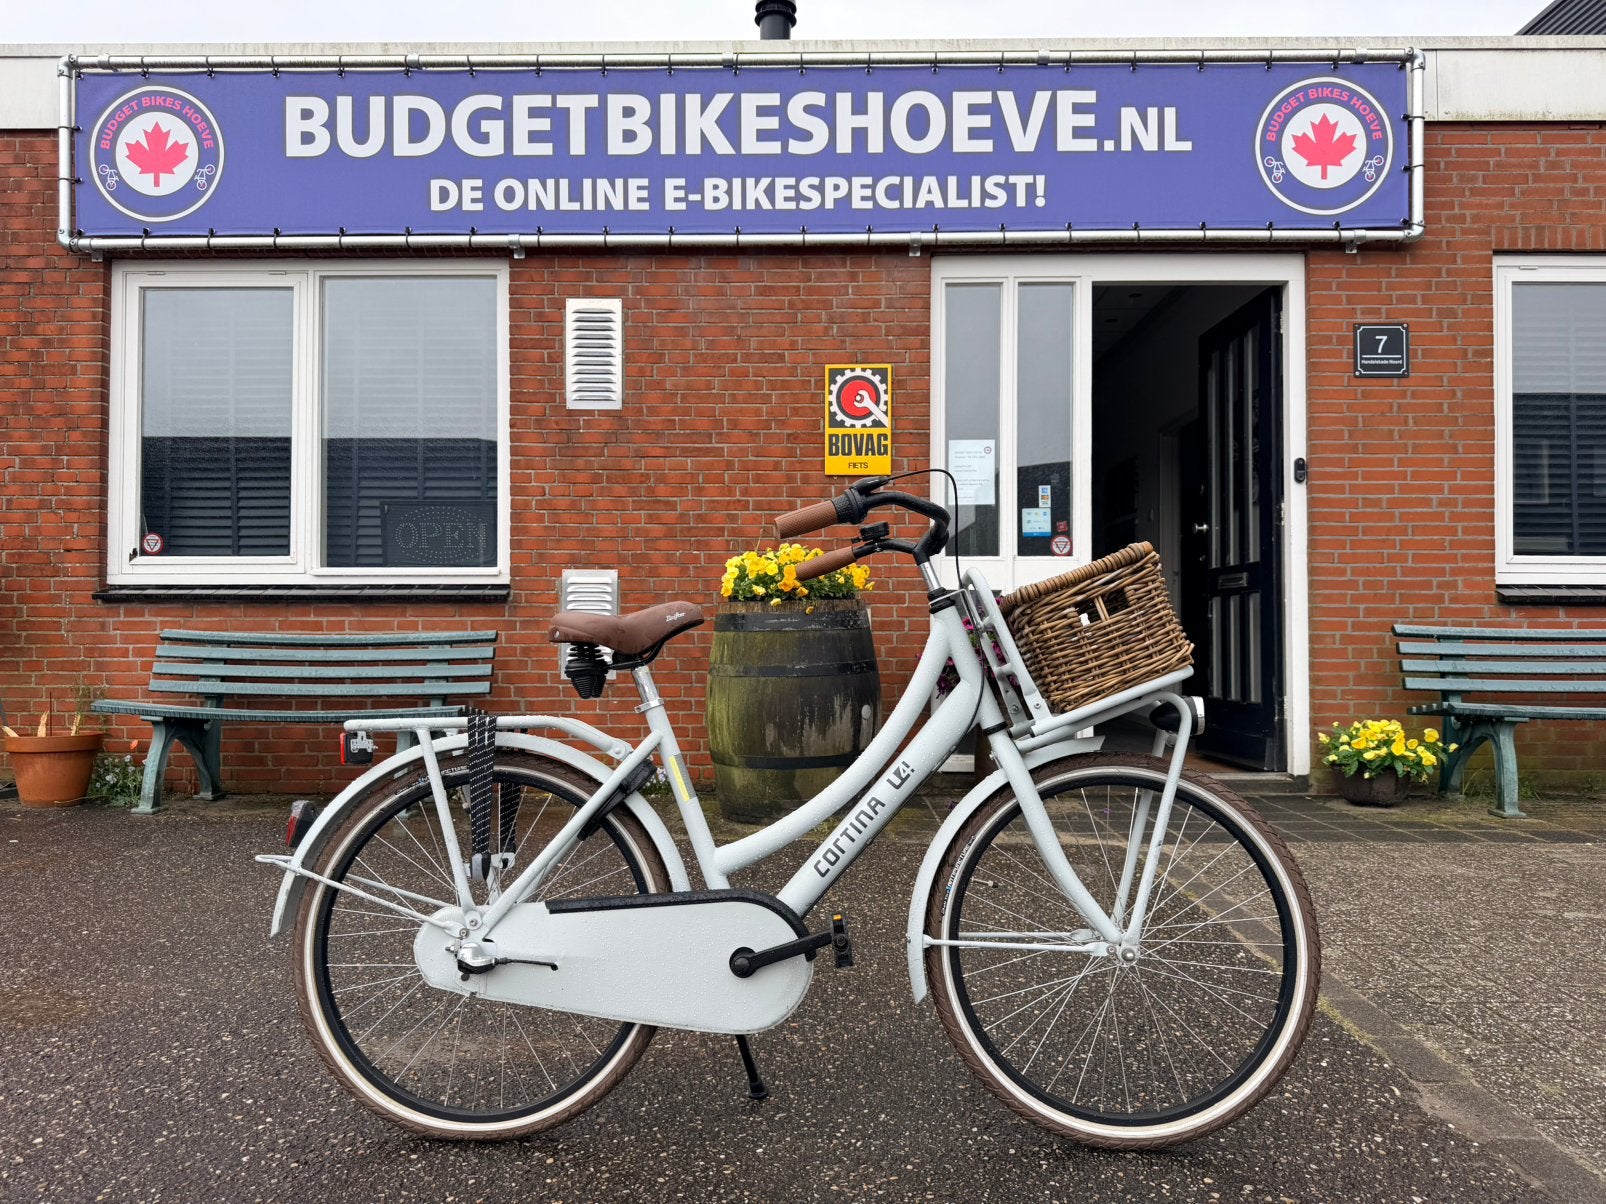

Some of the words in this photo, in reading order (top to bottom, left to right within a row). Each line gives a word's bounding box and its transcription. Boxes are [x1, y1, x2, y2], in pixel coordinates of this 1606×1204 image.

[101, 101, 139, 150] BUDGET
[141, 96, 182, 110] BIKES
[182, 105, 214, 149] HOEVE
[285, 90, 1193, 158] BUDGETBIKESHOEVE.NL
[1266, 92, 1305, 142] BUDGET
[1308, 87, 1350, 101] BIKES
[1350, 97, 1382, 140] HOEVE
[430, 178, 484, 211] DE
[493, 178, 650, 211] ONLINE
[664, 174, 1046, 211] E-BIKESPECIALIST!
[1375, 335, 1388, 354] 7
[828, 433, 889, 457] BOVAG
[394, 522, 488, 549] OPEN
[813, 796, 886, 878] CORTINA
